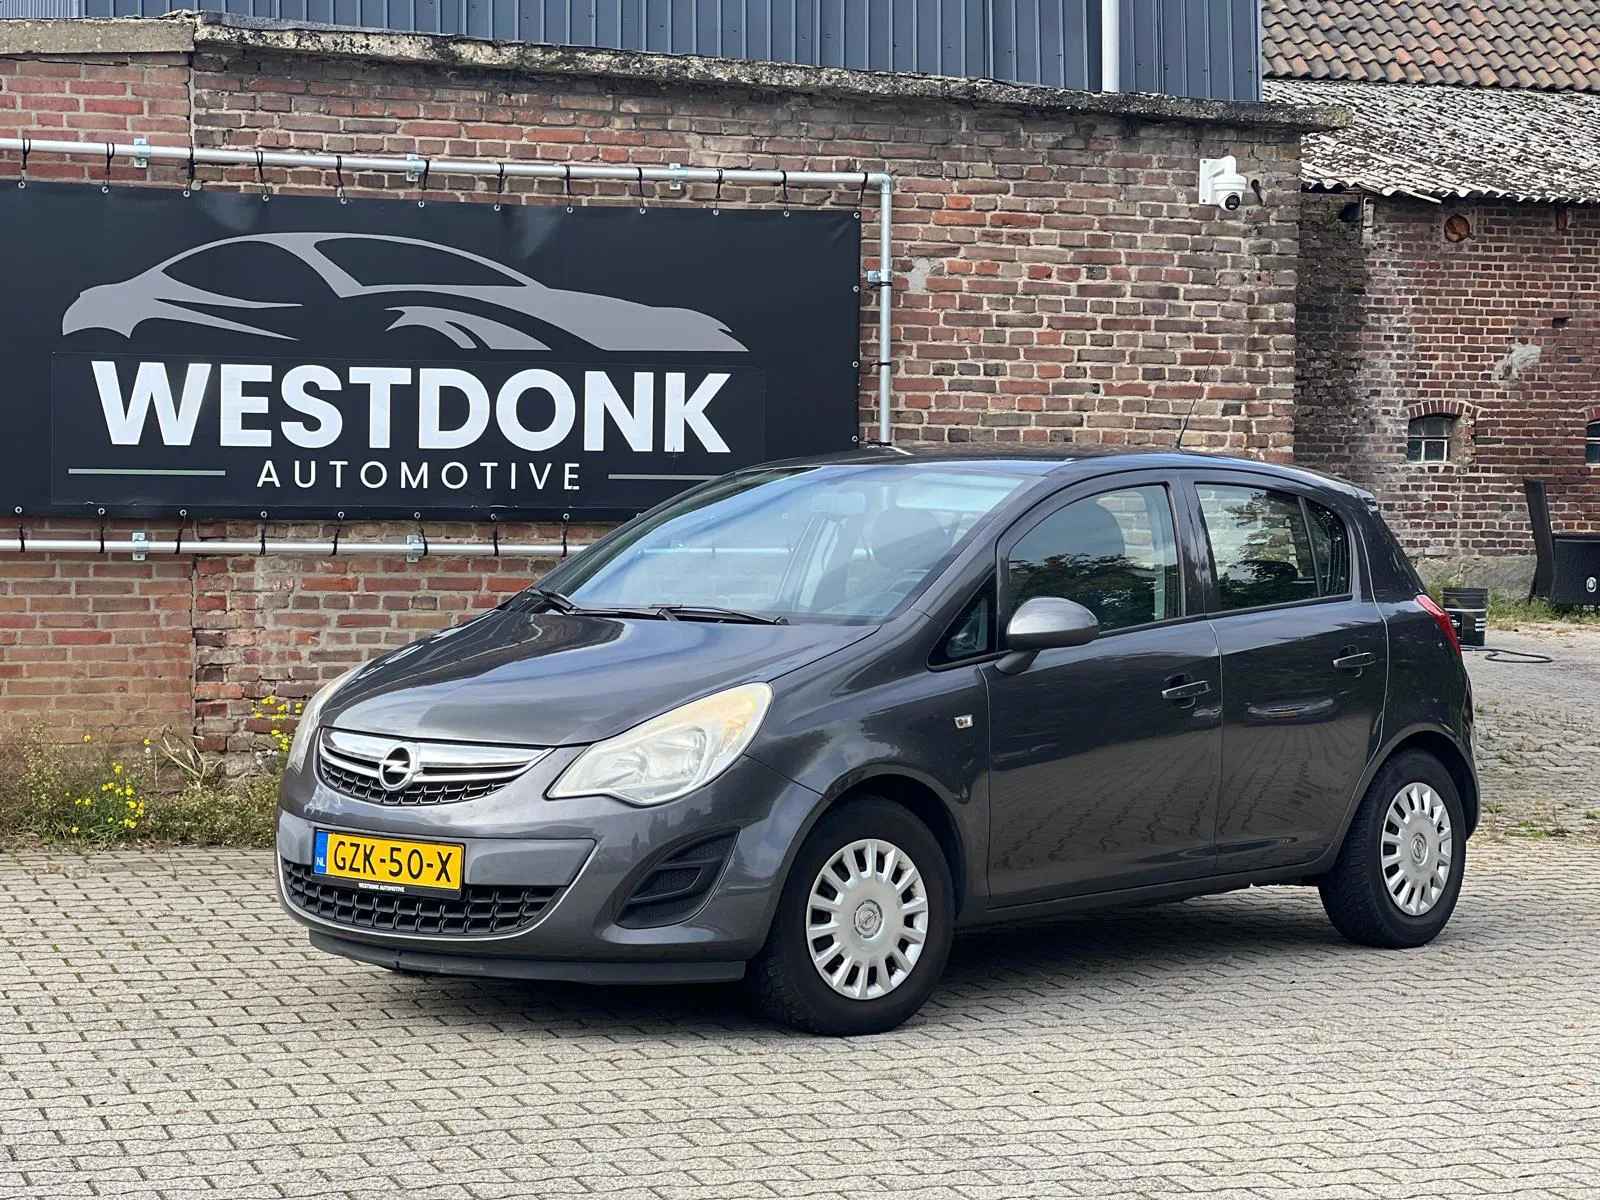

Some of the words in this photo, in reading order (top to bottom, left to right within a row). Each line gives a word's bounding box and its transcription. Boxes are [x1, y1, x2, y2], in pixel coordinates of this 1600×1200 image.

[92, 361, 731, 453] WESTDONK
[257, 460, 580, 490] AUTOMOTIVE
[316, 857, 326, 867] NL
[333, 840, 453, 882] GZK-50-X
